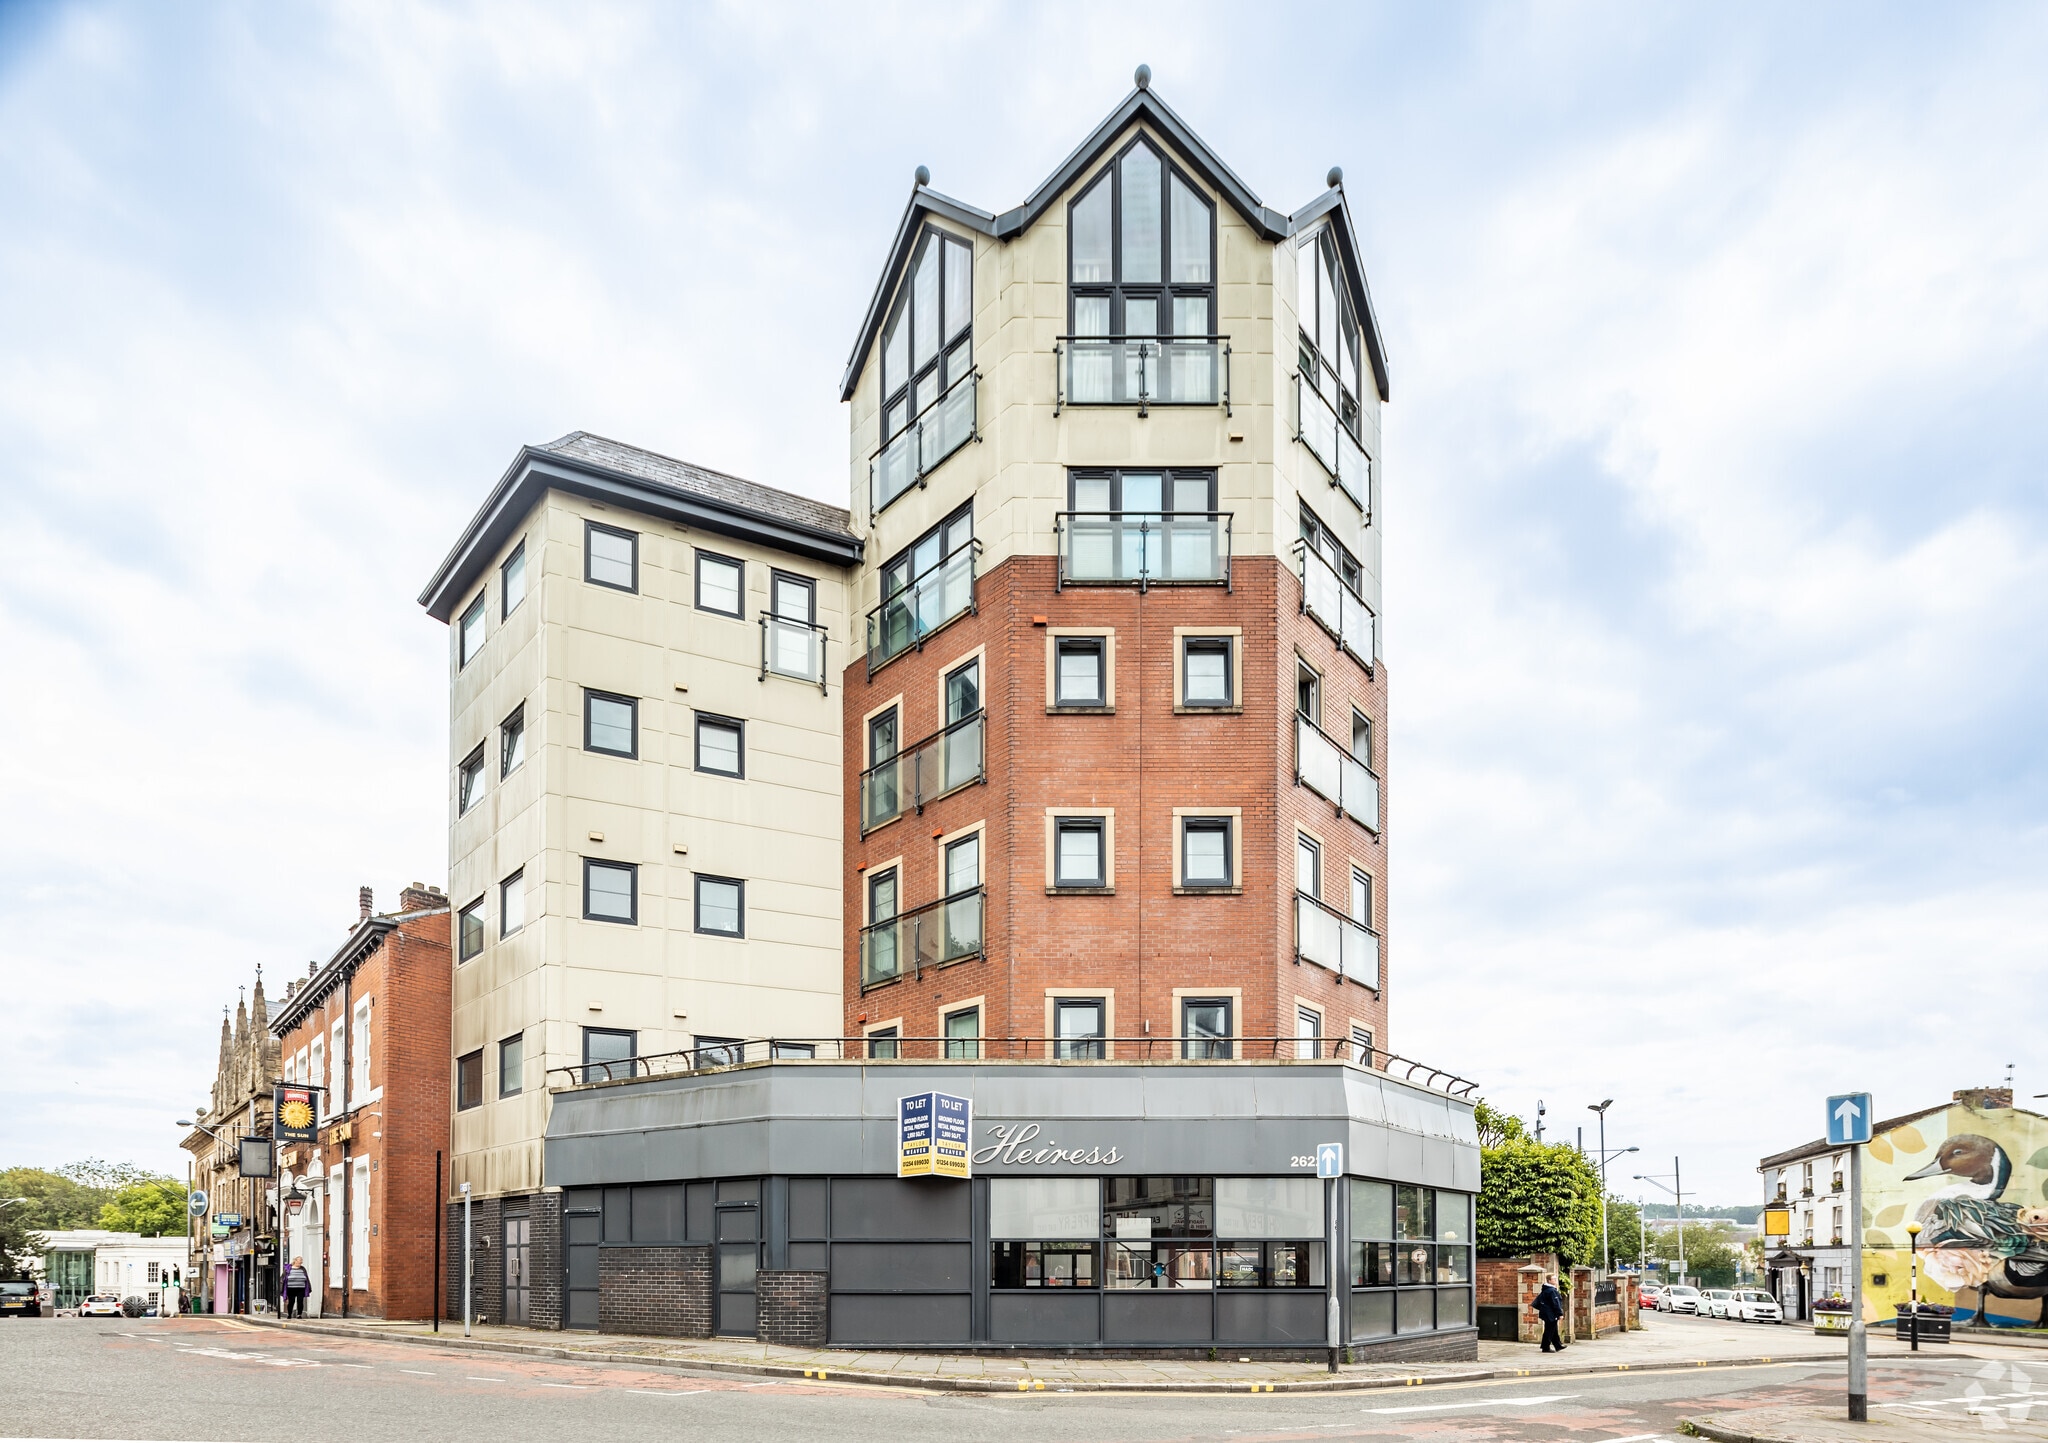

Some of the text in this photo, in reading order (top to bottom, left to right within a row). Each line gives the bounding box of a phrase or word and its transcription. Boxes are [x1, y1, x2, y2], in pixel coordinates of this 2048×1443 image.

[906, 1099, 926, 1111] TO LET
[941, 1099, 963, 1111] TO LET
[329, 1121, 352, 1145] THE SUN
[971, 1123, 1124, 1165] Heiress
[940, 1148, 962, 1156] WEAVER
[936, 1159, 949, 1167] 01254
[1290, 1155, 1318, 1167] 262
